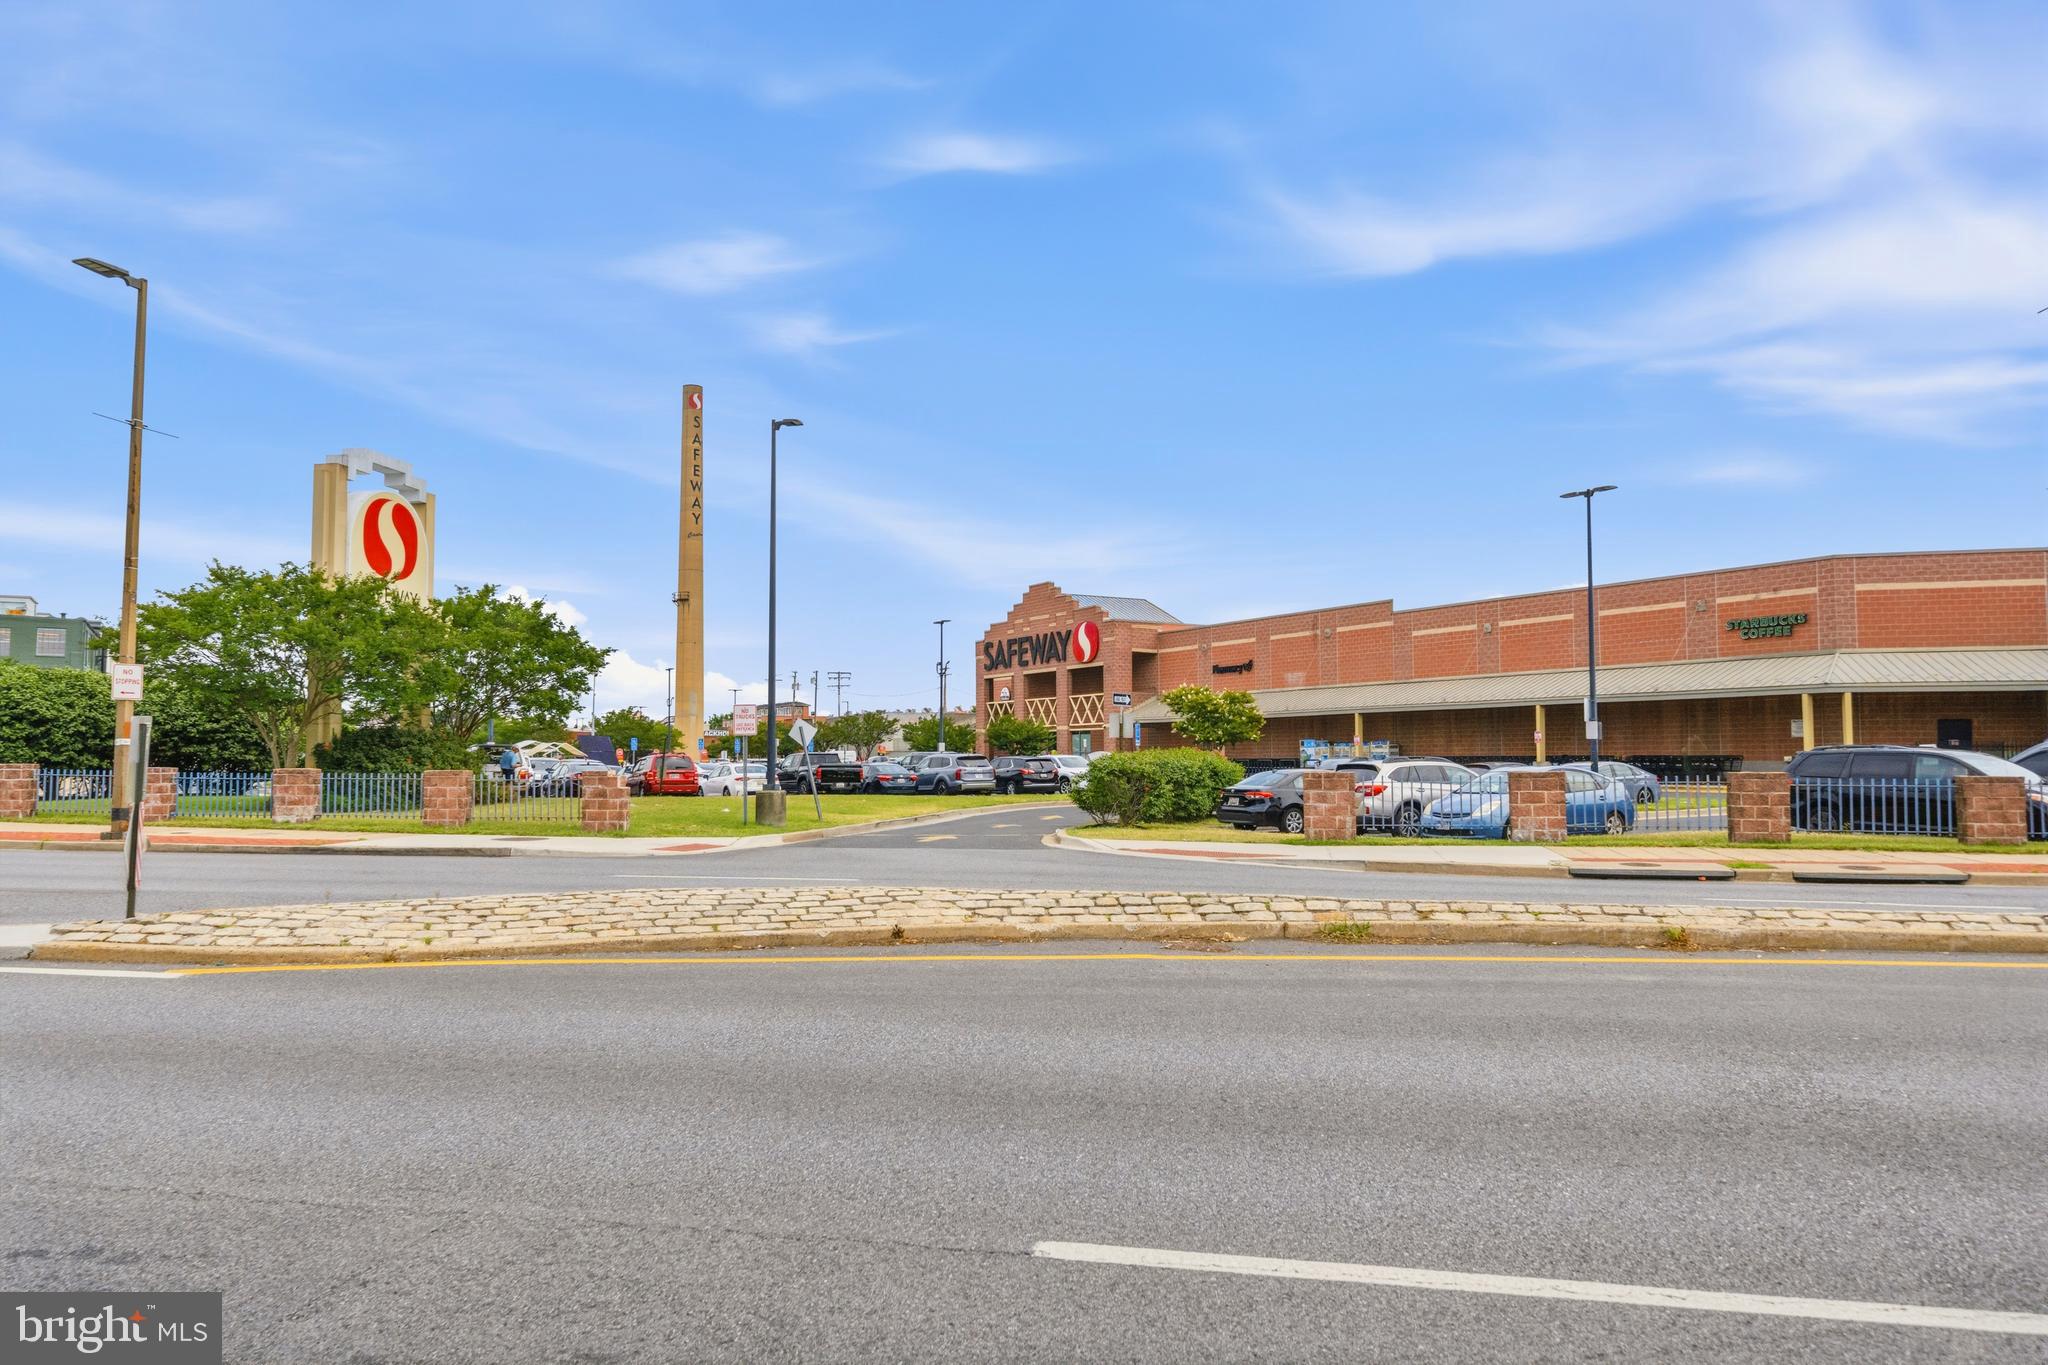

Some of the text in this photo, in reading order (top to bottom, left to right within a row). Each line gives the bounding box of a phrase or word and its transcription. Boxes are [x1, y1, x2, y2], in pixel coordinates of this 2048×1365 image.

[690, 415, 703, 525] SAFEWAY
[1724, 613, 1808, 631] STARBUCKS
[1740, 625, 1793, 640] COFFEE
[984, 630, 1072, 671] SAFEWAY
